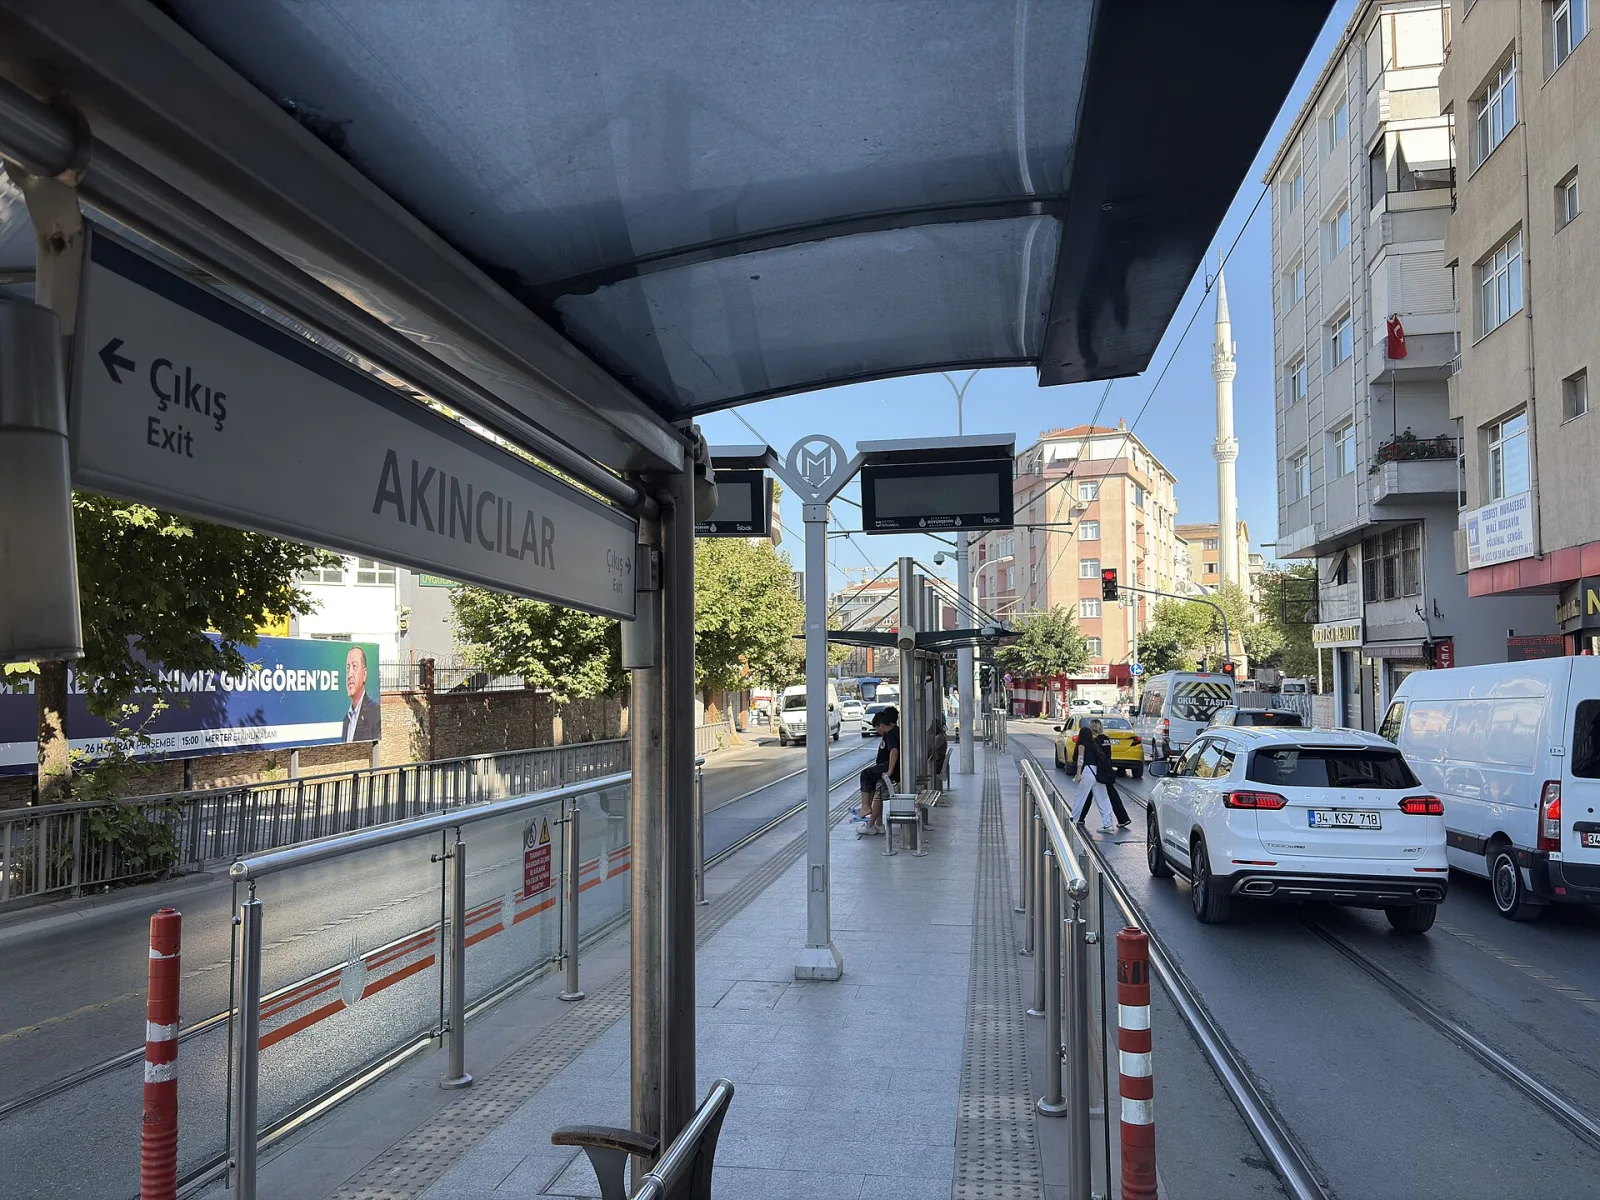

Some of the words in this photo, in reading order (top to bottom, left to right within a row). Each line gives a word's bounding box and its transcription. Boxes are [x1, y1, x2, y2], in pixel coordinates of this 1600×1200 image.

[150, 358, 227, 432] Çıkış
[147, 416, 194, 458] Exit
[372, 448, 556, 571] AKINCILAR
[607, 548, 623, 577] Çıkış
[613, 577, 623, 594] Exit
[1177, 697, 1199, 705] OKUL
[85, 743, 95, 754] 26
[181, 735, 199, 746] 15:00
[205, 733, 232, 743] MERTER
[1316, 812, 1329, 824] 34
[1334, 813, 1355, 825] KSZ
[1360, 814, 1378, 825] 718
